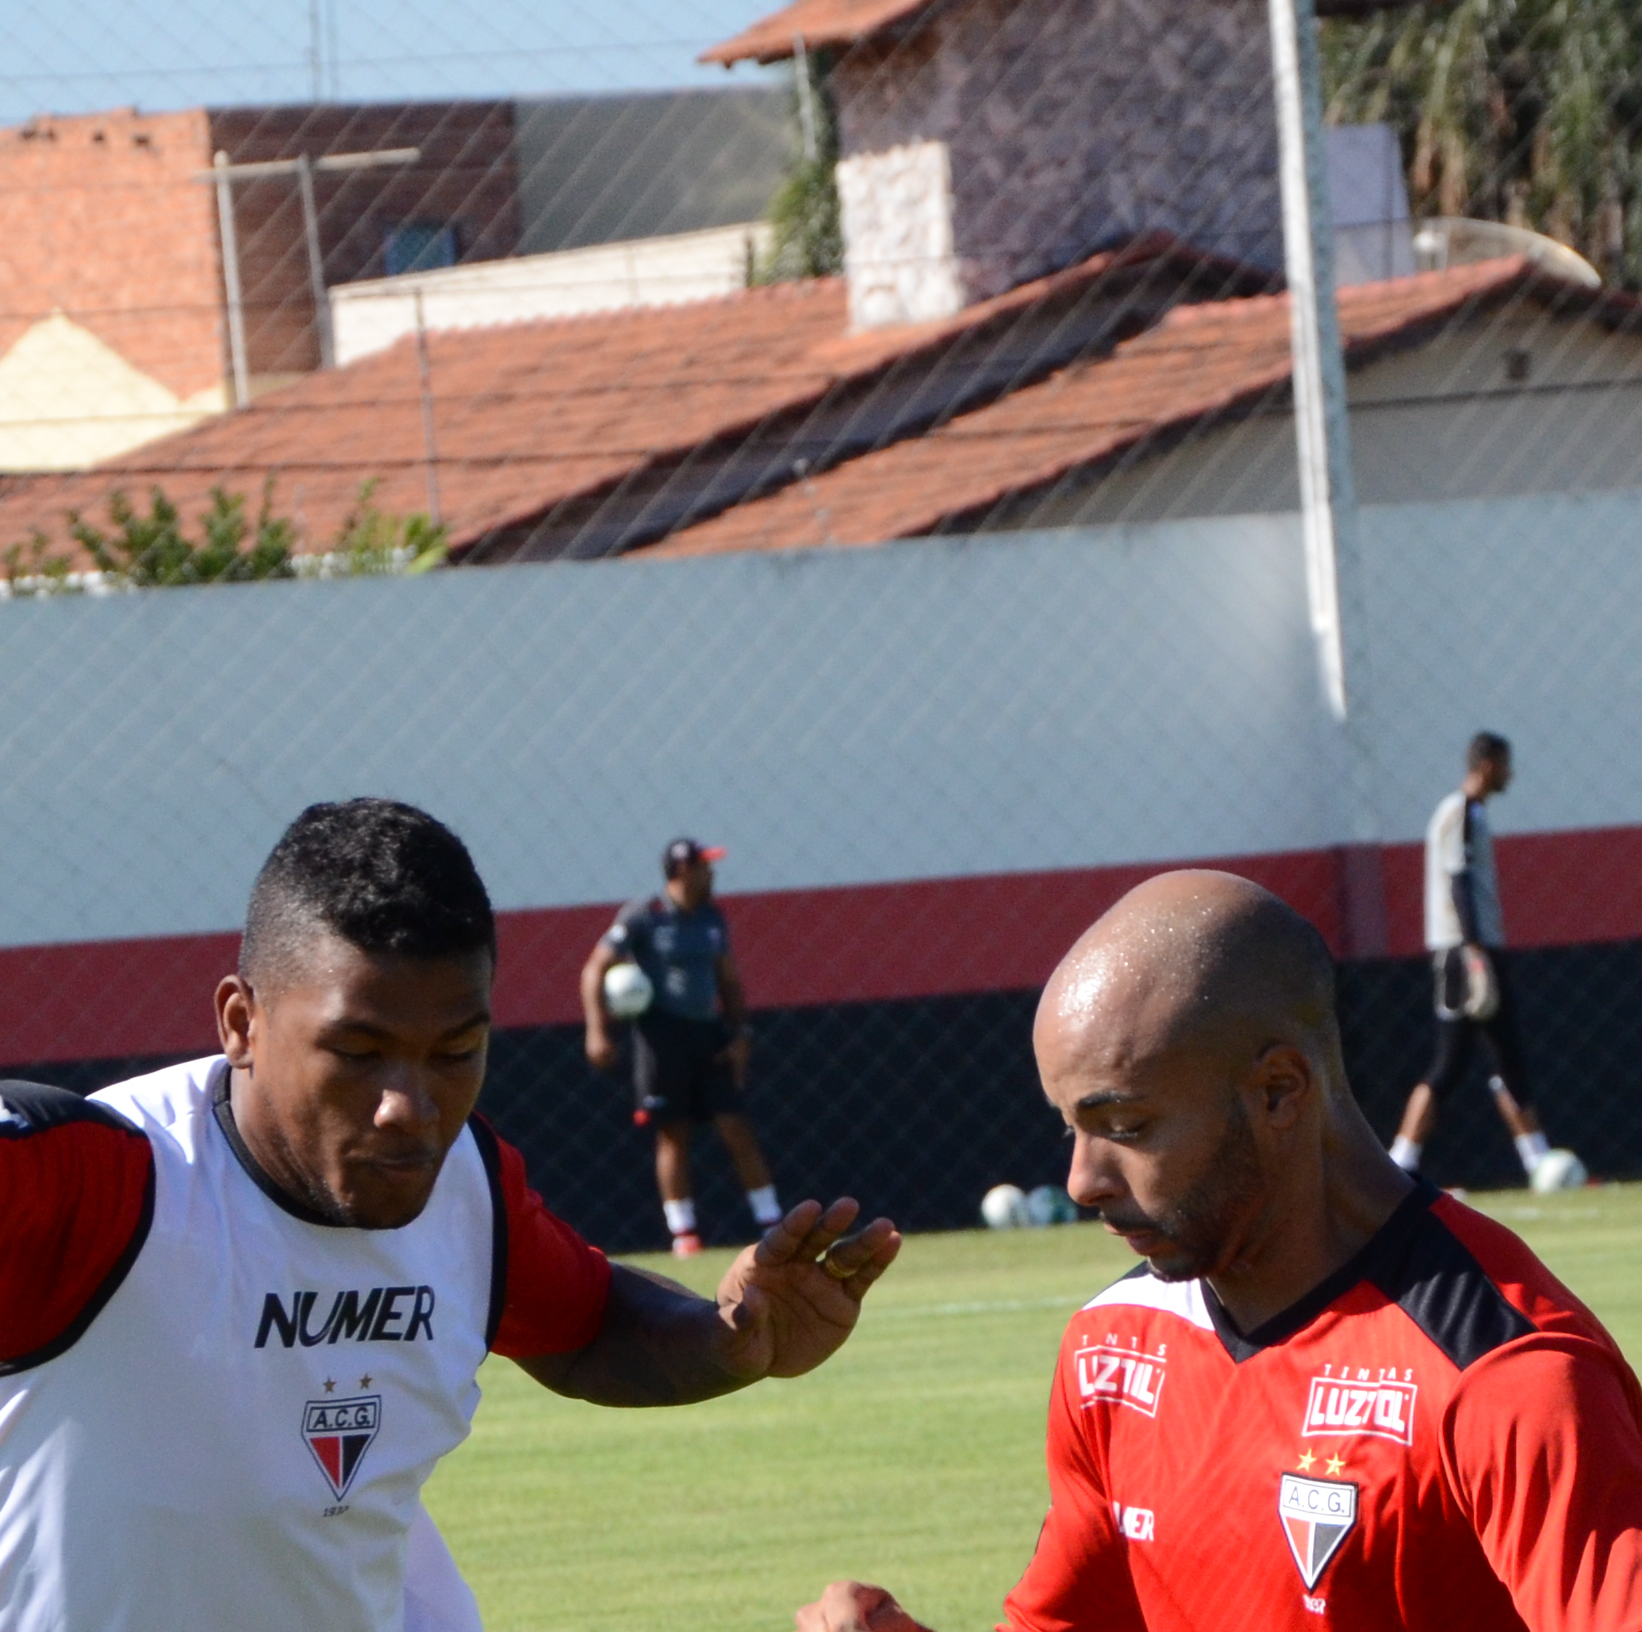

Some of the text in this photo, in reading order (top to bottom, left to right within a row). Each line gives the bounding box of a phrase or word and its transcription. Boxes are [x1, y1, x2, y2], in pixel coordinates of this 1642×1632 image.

[254, 1285, 435, 1348] NUMER
[1323, 1363, 1413, 1382] TINTAS
[313, 1406, 371, 1430] A.C.G.
[1310, 1386, 1405, 1433] LUZTOL
[1288, 1485, 1346, 1514] A.C.G.
